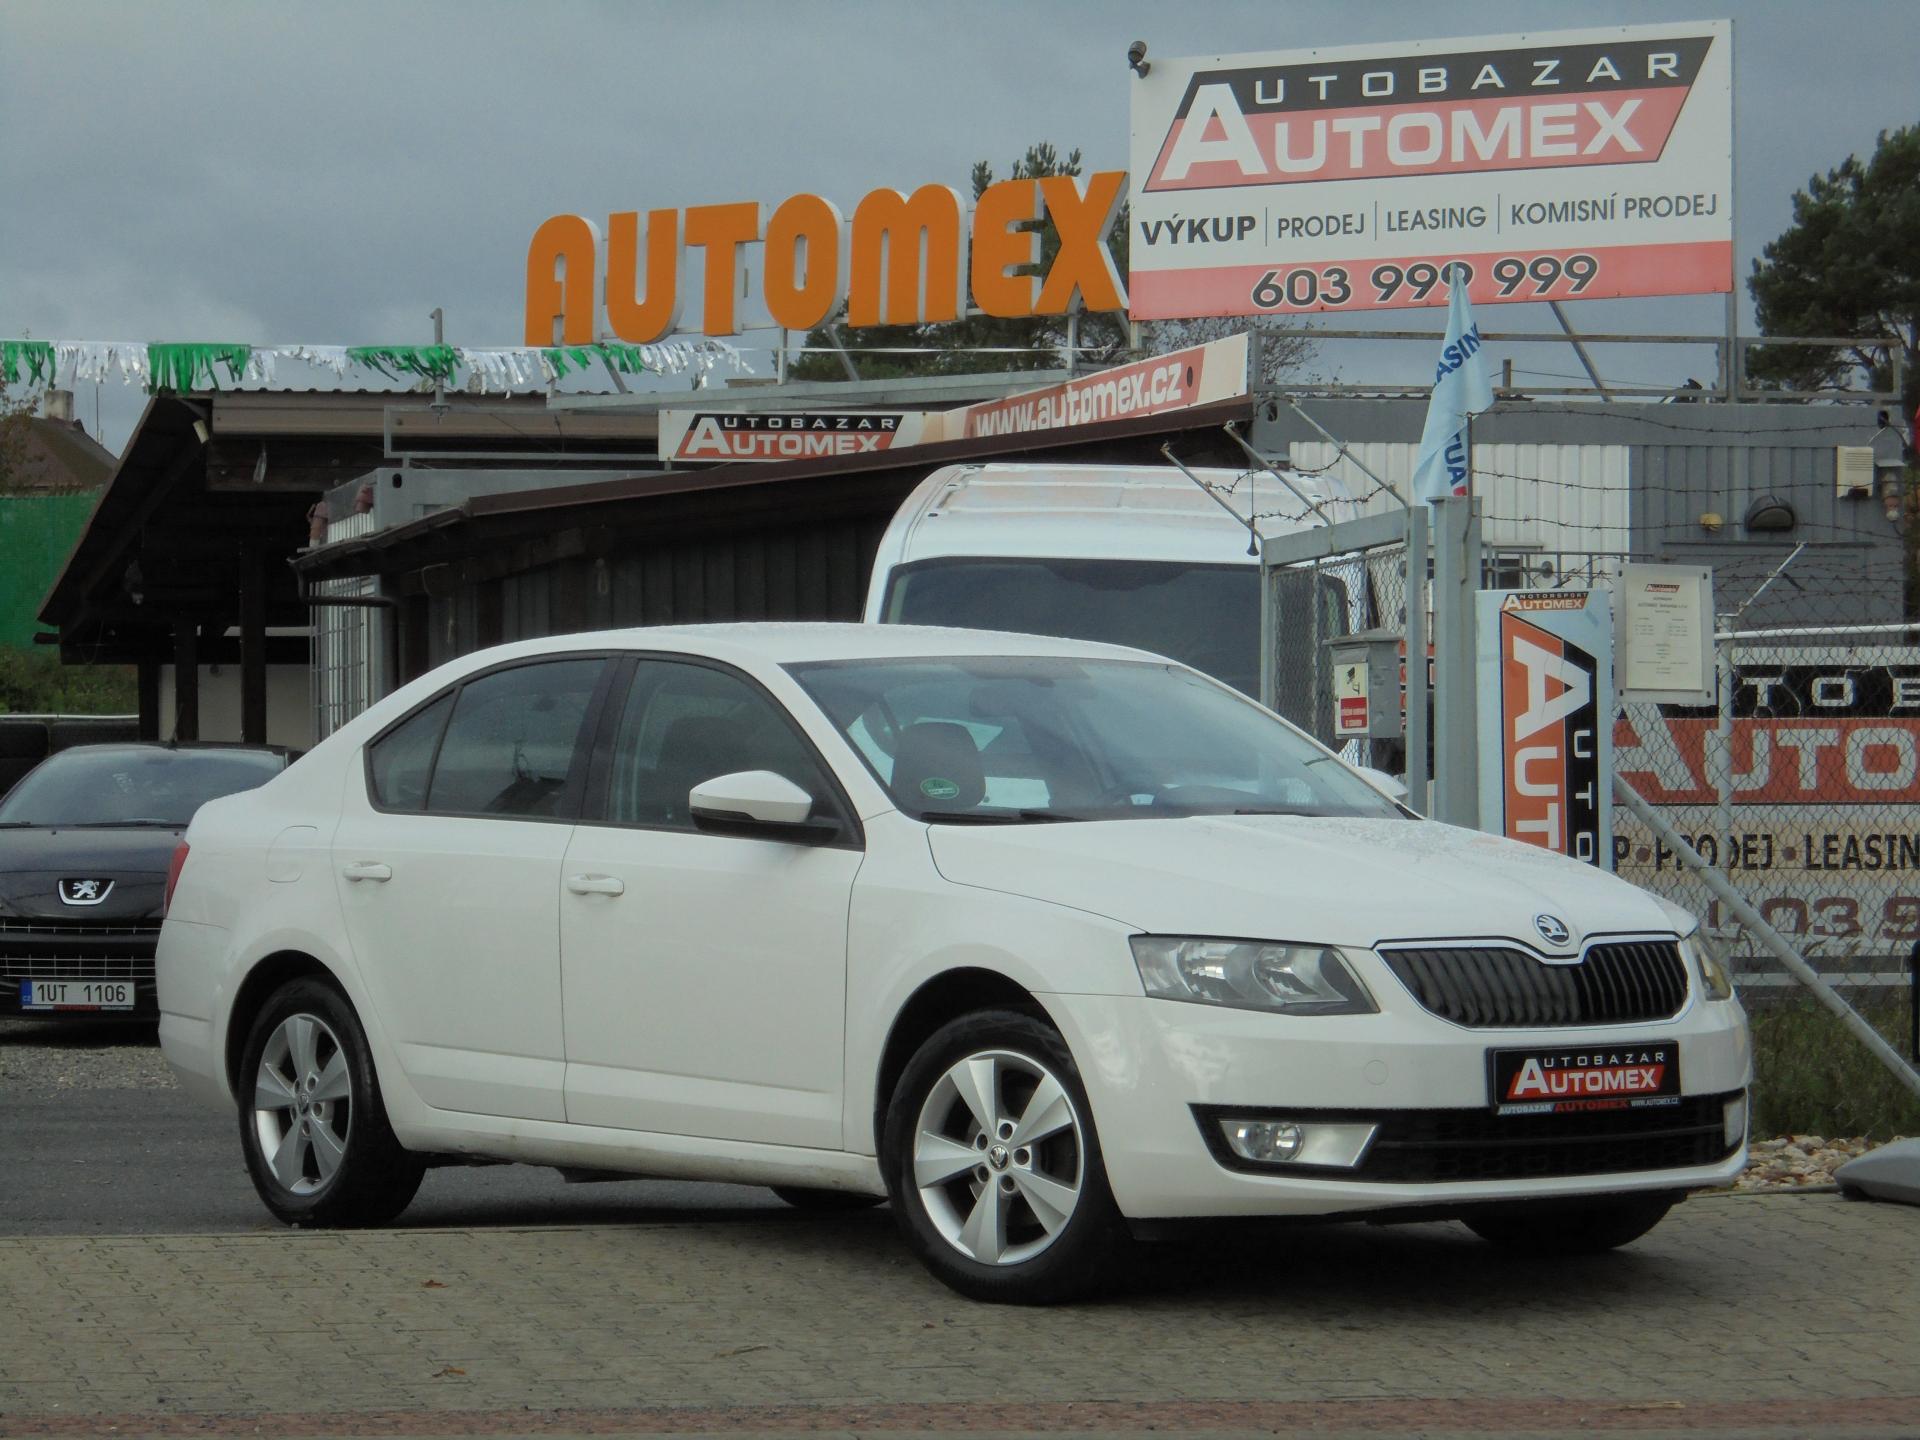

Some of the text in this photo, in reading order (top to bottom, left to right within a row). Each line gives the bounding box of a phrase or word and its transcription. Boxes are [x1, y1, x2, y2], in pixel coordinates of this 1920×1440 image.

[1160, 99, 1643, 181] AUTOMEX
[1141, 192, 1718, 246] VÝKUP PRODEJ LEASING KOMISNÍ PRODEJ
[526, 172, 1129, 347] AUTOMEX
[1251, 267, 1352, 309] 603
[1493, 254, 1600, 297] 999
[976, 361, 1183, 438] www.automex.cz
[685, 417, 881, 456] AUTOMEX
[1503, 594, 1582, 610] AUTOMEX
[37, 984, 126, 1002] 1UT 1106
[1514, 1058, 1657, 1095] AUTOMEX
